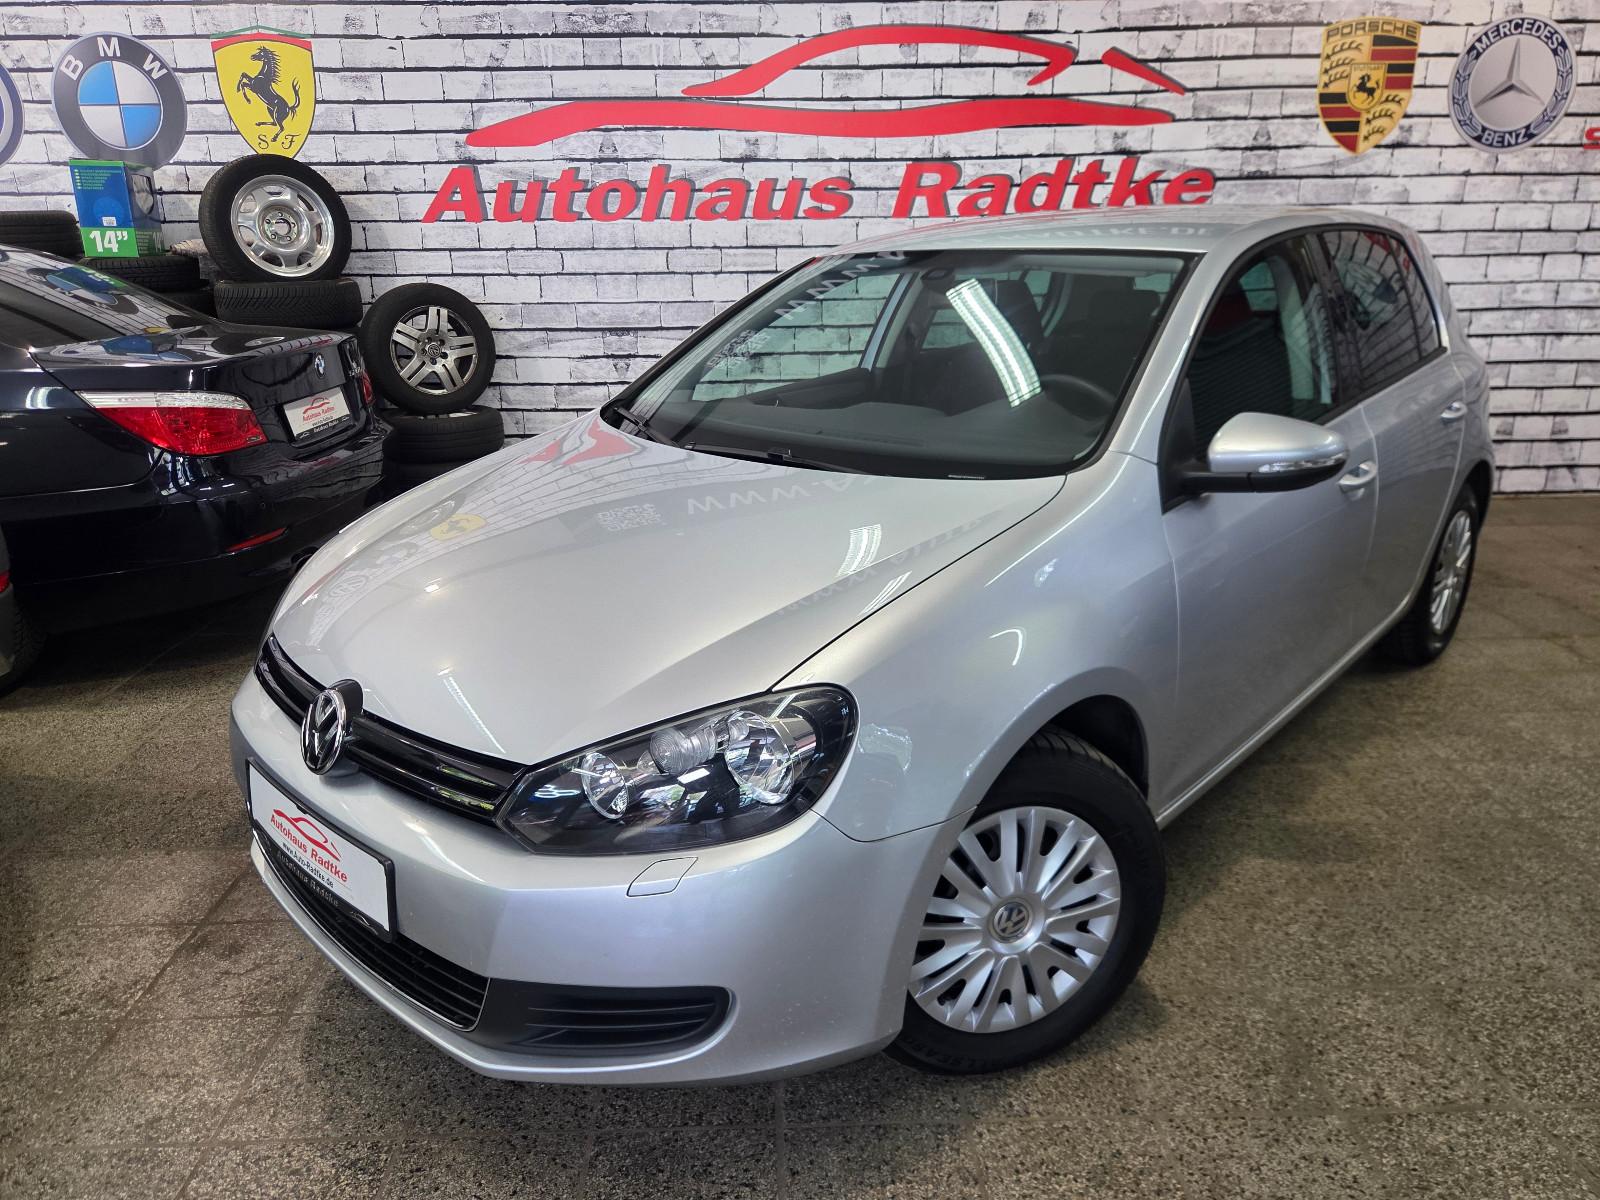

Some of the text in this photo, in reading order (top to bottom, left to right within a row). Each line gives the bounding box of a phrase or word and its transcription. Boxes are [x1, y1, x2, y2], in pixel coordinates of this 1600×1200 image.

[1326, 20, 1418, 41] PORSCHE
[1475, 18, 1563, 52] MERCEDES
[60, 36, 168, 80] BMW
[1481, 128, 1529, 147] BENZ
[421, 156, 1217, 223] Autohaus Radtke
[270, 814, 348, 882] Autohaus Radtke
